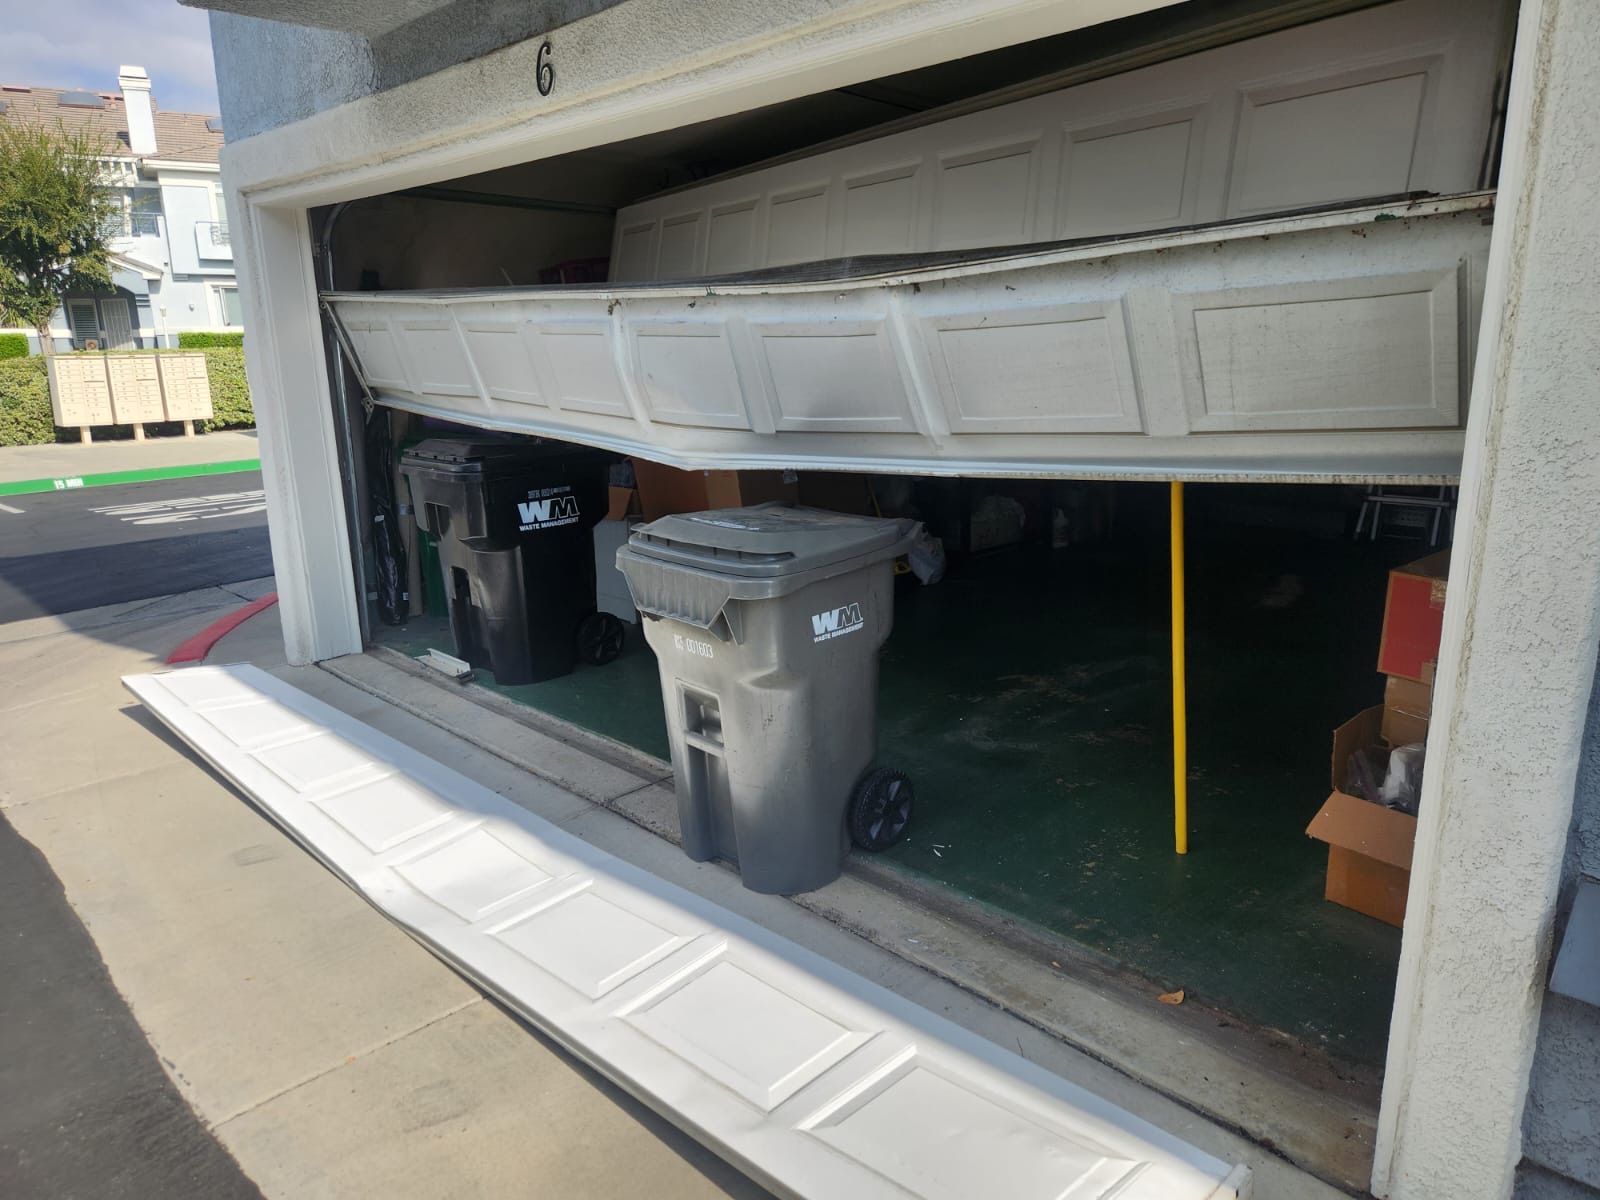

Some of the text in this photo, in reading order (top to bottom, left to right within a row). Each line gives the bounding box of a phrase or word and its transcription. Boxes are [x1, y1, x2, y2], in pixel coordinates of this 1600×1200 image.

[536, 41, 554, 96] 6
[517, 496, 580, 524] WM
[519, 517, 579, 532] WASTE MANAGEMENT
[812, 602, 863, 636] WM
